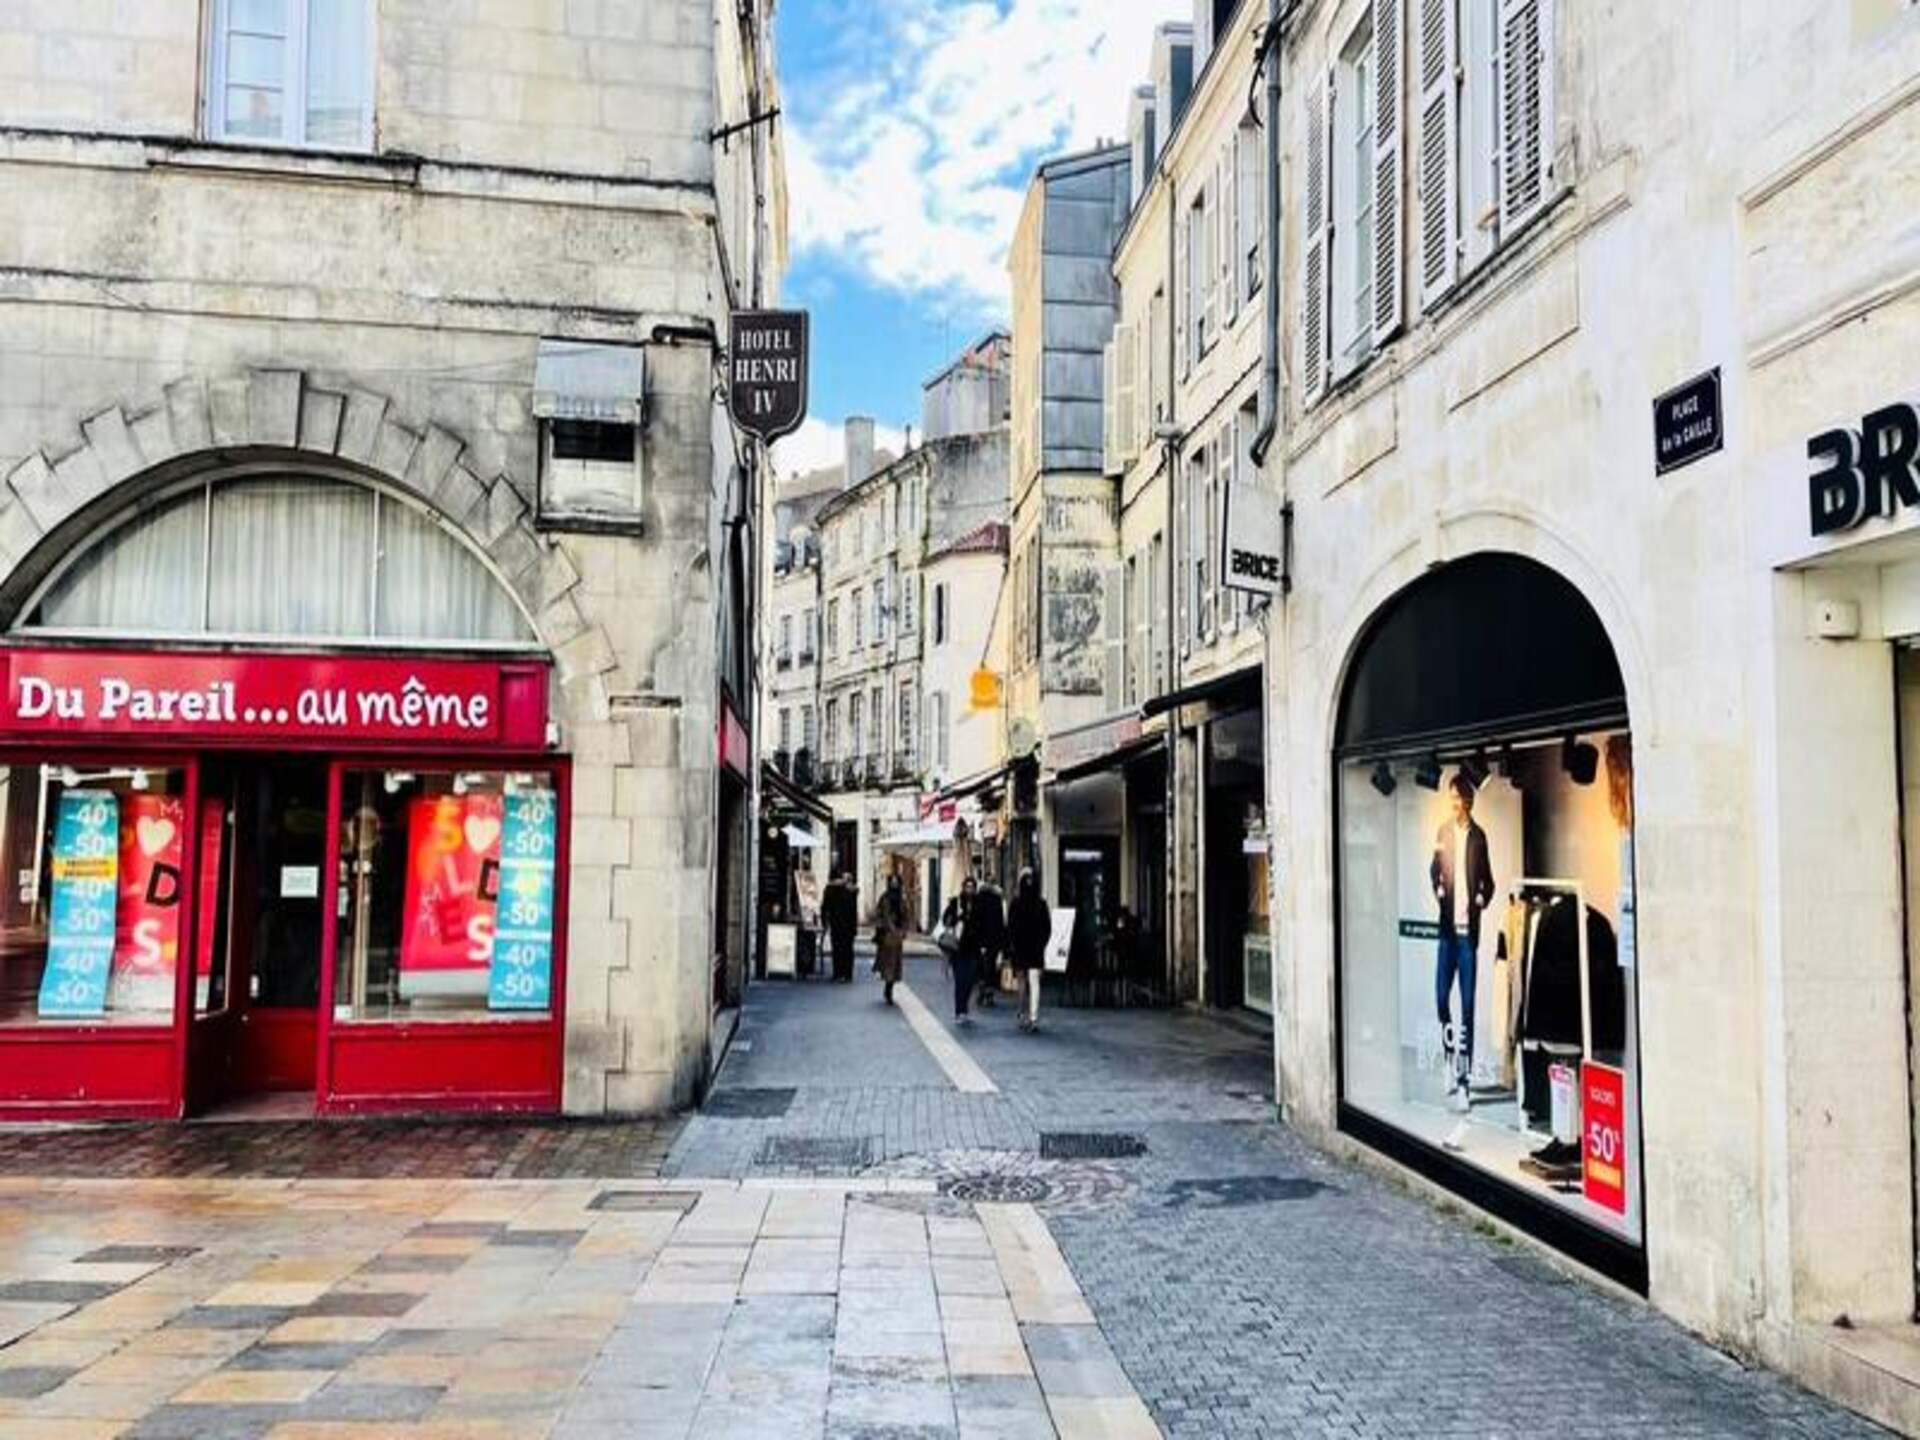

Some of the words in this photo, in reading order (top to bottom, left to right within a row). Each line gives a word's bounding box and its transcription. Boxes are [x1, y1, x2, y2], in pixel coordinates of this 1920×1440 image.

[740, 329, 793, 350] HOTEL
[736, 358, 798, 382] HENRI
[753, 389, 777, 415] IV
[1672, 395, 1699, 421] PLACE
[1683, 416, 1713, 443] CAILLE
[1231, 548, 1279, 582] BRICE
[17, 676, 85, 719] Du
[297, 688, 348, 726] au
[356, 675, 489, 728] même
